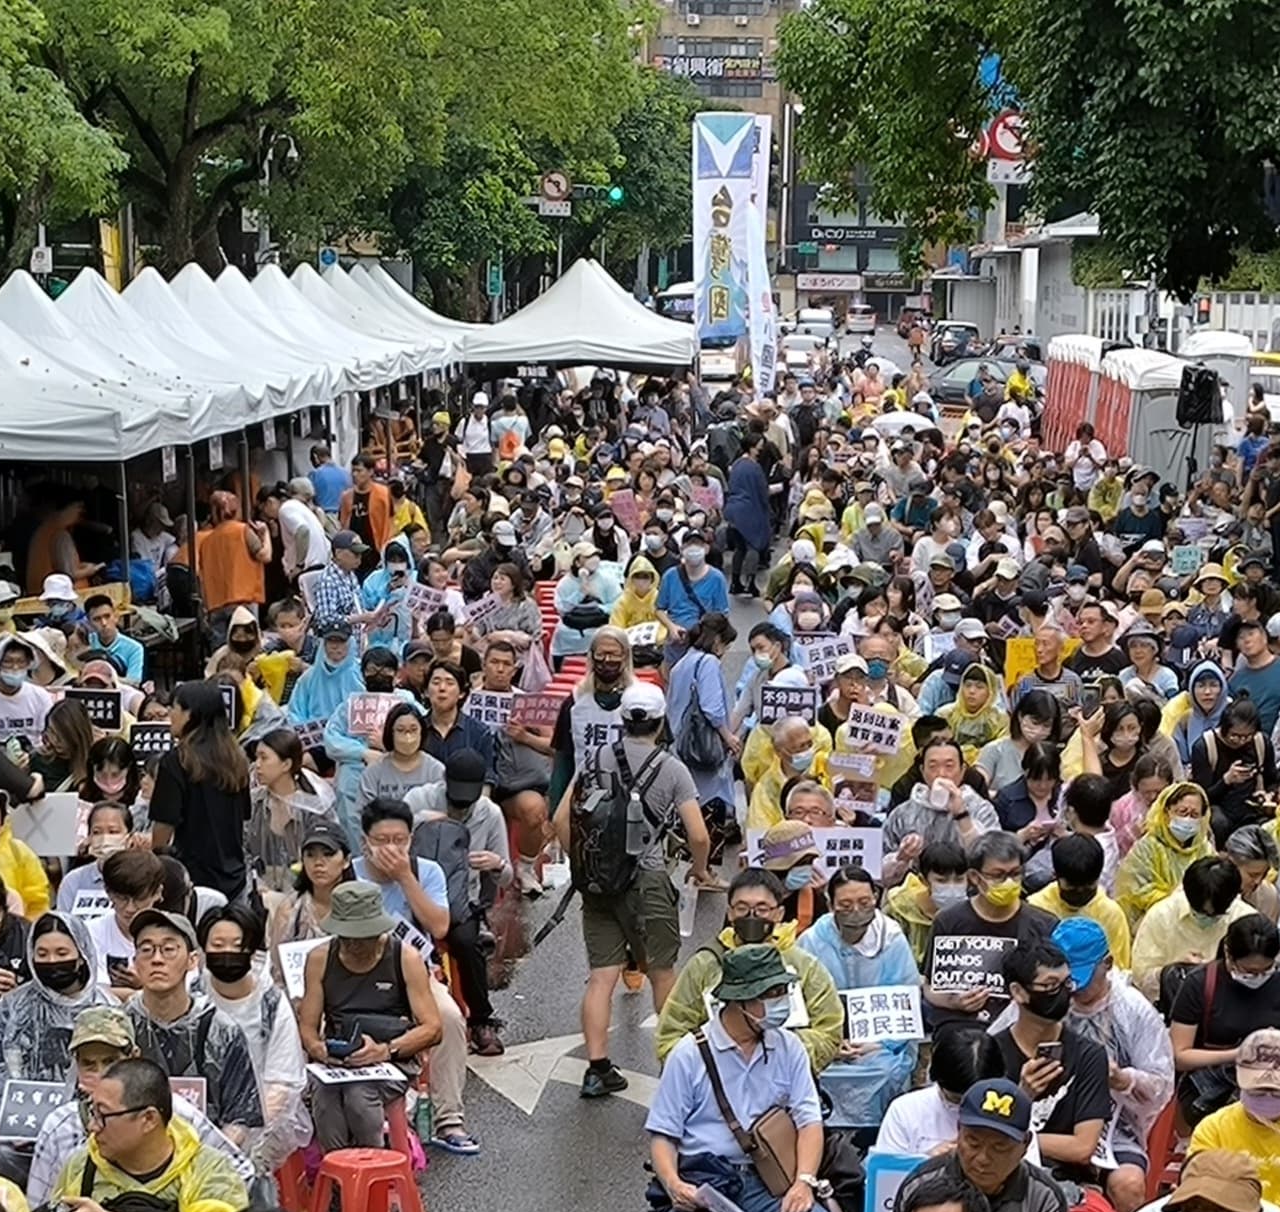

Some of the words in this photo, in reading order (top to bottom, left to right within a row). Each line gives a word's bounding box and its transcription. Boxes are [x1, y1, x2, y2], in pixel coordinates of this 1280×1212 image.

[936, 954, 984, 968] HANDS
[850, 993, 912, 1017] 反黑箱
[982, 1090, 1014, 1117] M
